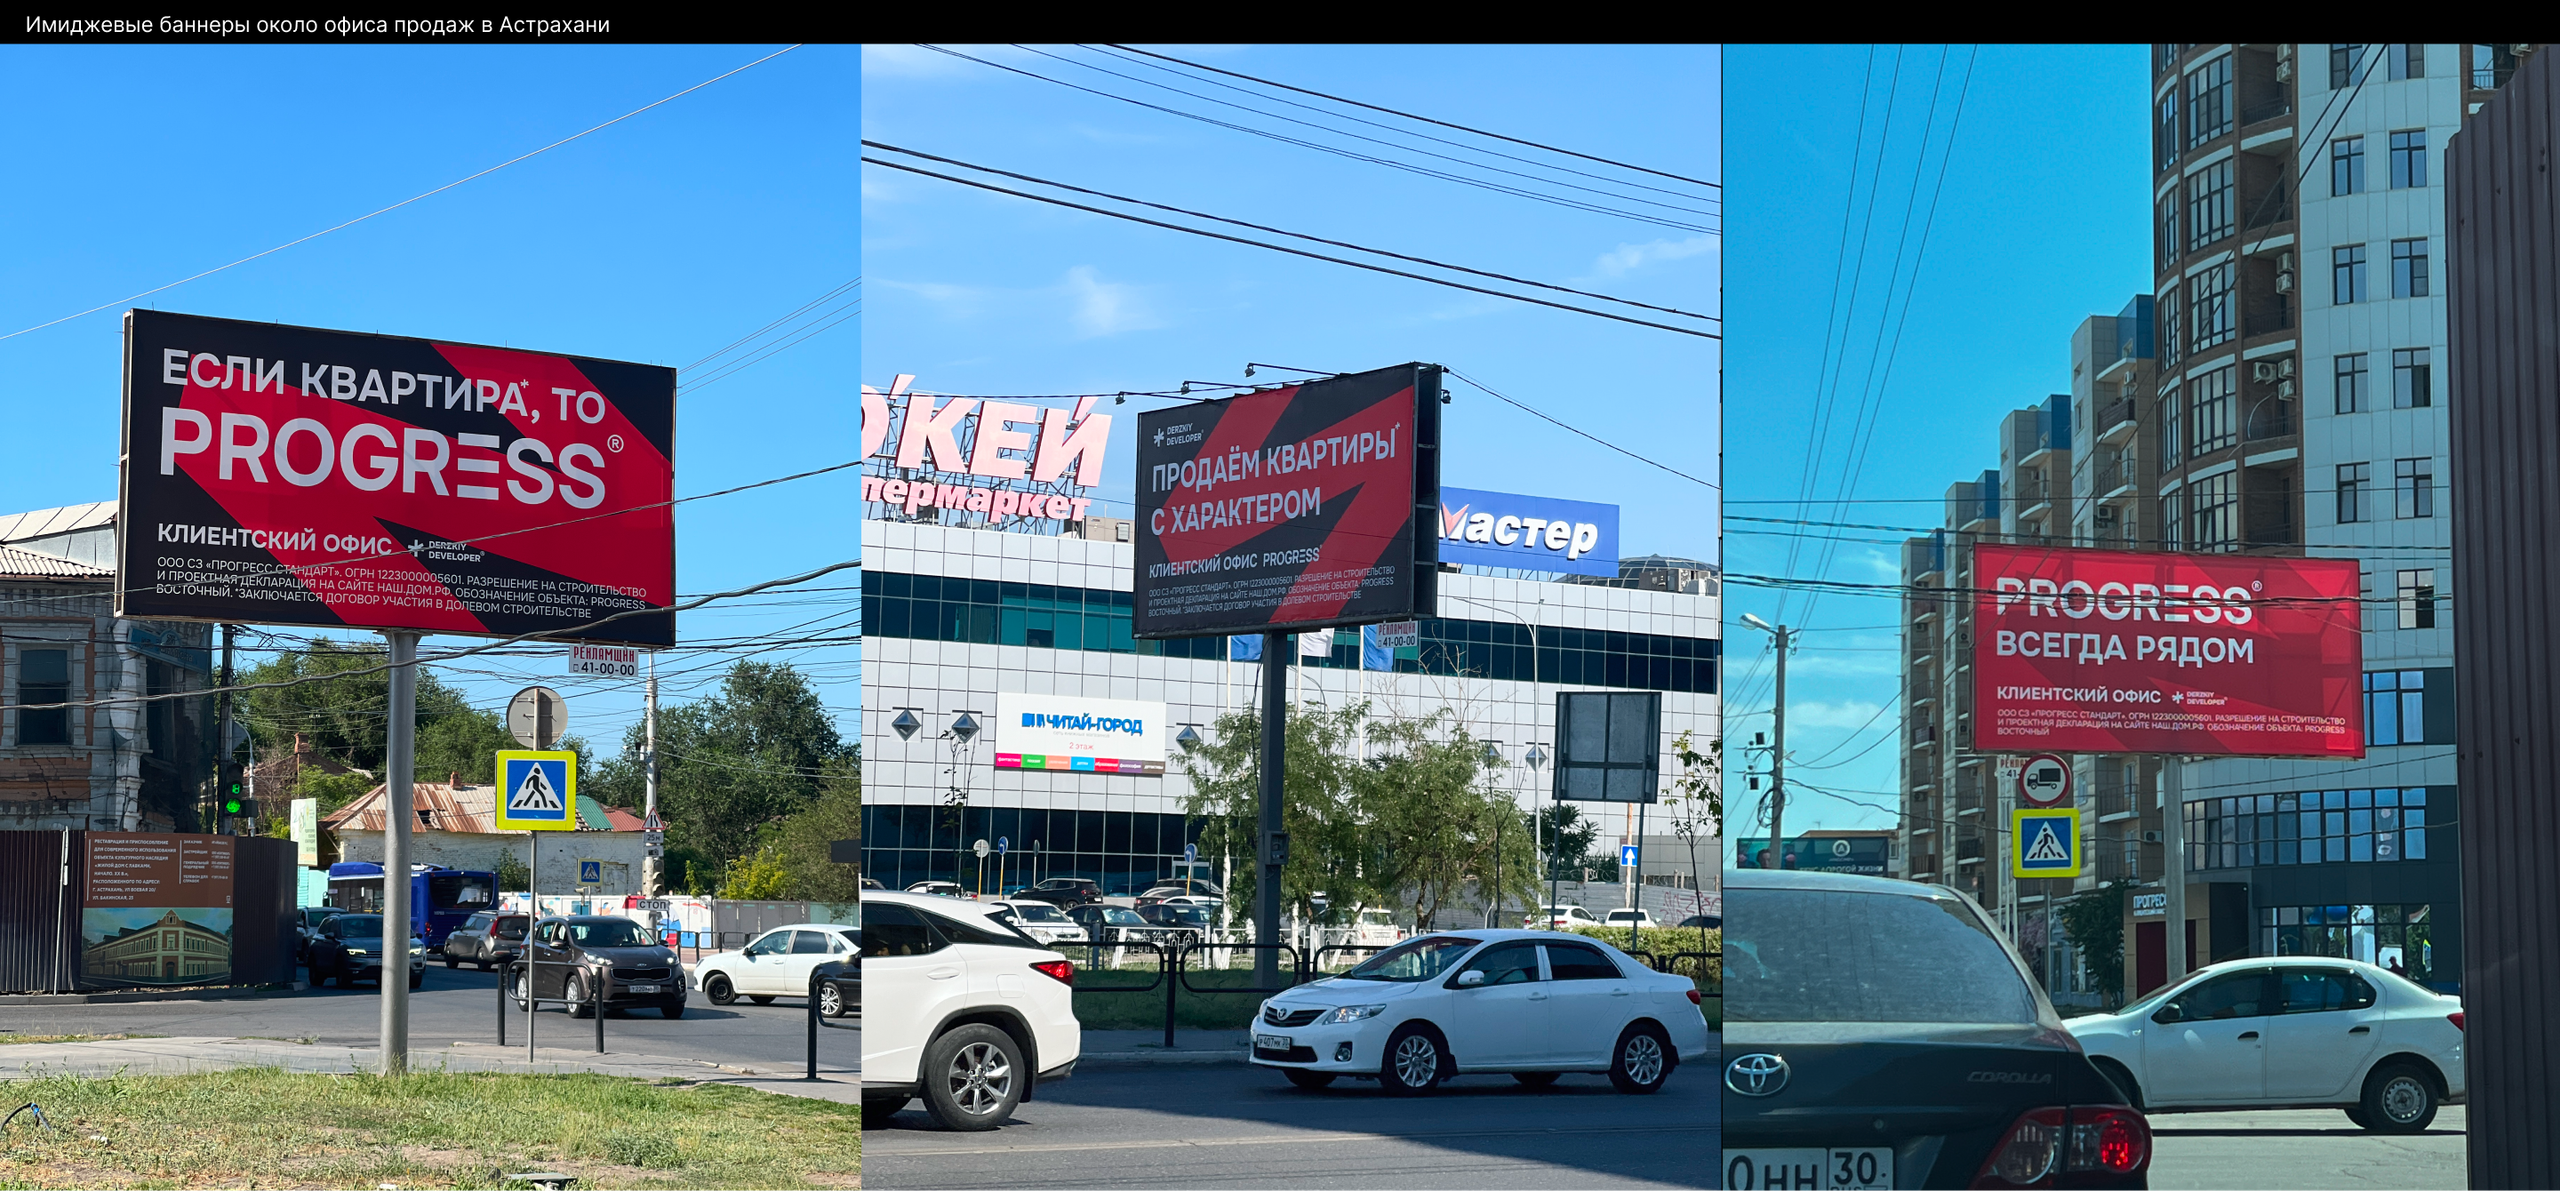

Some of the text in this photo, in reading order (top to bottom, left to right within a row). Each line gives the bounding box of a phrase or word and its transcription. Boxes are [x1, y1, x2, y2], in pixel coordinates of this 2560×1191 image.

[163, 348, 285, 394] ЕСЛИ
[551, 387, 606, 424] ТО
[1166, 422, 1193, 436] DERZKIY
[1152, 445, 1260, 493] ПРОДАЁМ
[1151, 486, 1321, 536] С ХАРАКТЕРОМ
[158, 523, 392, 555] КЛИЕНТСКИЙ ОФИС
[1438, 502, 1599, 561] Мастер
[428, 540, 467, 551] DERZKIY
[157, 557, 184, 568] ООО
[206, 559, 273, 574] «ПРОГРЕСС
[345, 567, 374, 579] ОГРН
[467, 576, 538, 590] РАЗРЕШЕНИЕ
[541, 580, 556, 591] НА
[558, 582, 647, 598] СТРОИТЕЛЬСТВО
[1149, 553, 1221, 578] КЛИЕНТСКИЙ
[1223, 553, 1258, 571] ОФИС
[157, 570, 166, 580] И
[169, 570, 238, 585] ПРОЕКТНАЯ
[240, 574, 316, 590] ДЕКЛАРАЦИЯ
[319, 579, 335, 589] НА
[338, 578, 375, 592] САЙТЕ
[455, 588, 535, 601] ОБОЗНАЧЕНИЕ
[537, 592, 589, 606] ОБЪЕКТА:
[591, 597, 646, 610] PROGRESS
[1148, 588, 1161, 598] ООО
[1233, 580, 1249, 589] ОГРН
[1294, 571, 1333, 583] РАЗРЕШЕНИЕ
[1333, 571, 1342, 579] НА
[1343, 565, 1395, 578] СТРОИТЕЛЬСТВО
[1148, 599, 1153, 607] И
[1153, 596, 1184, 607] ПРОЕКТНАЯ
[1185, 593, 1220, 606] ДЕКЛАРАЦИЯ
[1220, 592, 1229, 600] НА
[1229, 589, 1248, 600] САЙТЕ
[1288, 582, 1330, 595] ОБОЗНАЧЕНИЕ
[1361, 577, 1394, 587] PROGRESS
[156, 583, 233, 598] ВОСТОЧНЫЙ.
[325, 592, 380, 606] ДОГОВОР
[383, 594, 433, 608] УЧАСТИЯ
[436, 598, 443, 609] В
[445, 599, 500, 613] ДОЛЕВОМ
[502, 603, 592, 619] СТРОИТЕЛЬСТВЕ
[1223, 600, 1251, 612] ДОГОВОР
[1251, 597, 1277, 608] УЧАСТИЯ
[1277, 597, 1282, 605] В
[1282, 596, 1312, 607] ДОЛЕВОМ
[1312, 590, 1362, 603] СТРОИТЕЛЬСТВЕ
[1382, 635, 1416, 647] 41-00-00
[1996, 630, 2254, 669] ВСЕГДА РЯДОМ
[581, 662, 635, 676] 41-00-00
[1997, 686, 2162, 704] КЛИЕНТСКИЙ ОФИС
[1046, 712, 1143, 737] ЧИТАЙ-ГОРОД
[1997, 709, 2016, 717] ООО
[2031, 709, 2078, 718] «ПРОГРЕСС
[2128, 712, 2150, 720] ОГРН
[2215, 714, 2267, 723] РАЗРЕШЕНИЕ
[2268, 715, 2280, 723] НА
[2281, 715, 2346, 726] СТРОИТЕЛЬСТВО
[2006, 719, 2054, 727] ПРОЕКТНАЯ
[2056, 720, 2109, 729] ДЕКЛАРАЦИЯ
[2124, 720, 2150, 729] САЙТЕ
[2207, 723, 2265, 732] ОБОЗНАЧЕНИЕ
[2304, 726, 2346, 734] PROGRESS
[1997, 726, 2050, 736] ВОСТОЧНЫЙ
[639, 900, 667, 909] СТОП
[1966, 1071, 2052, 1084] COROLLA
[1834, 1152, 1877, 1185] 30
